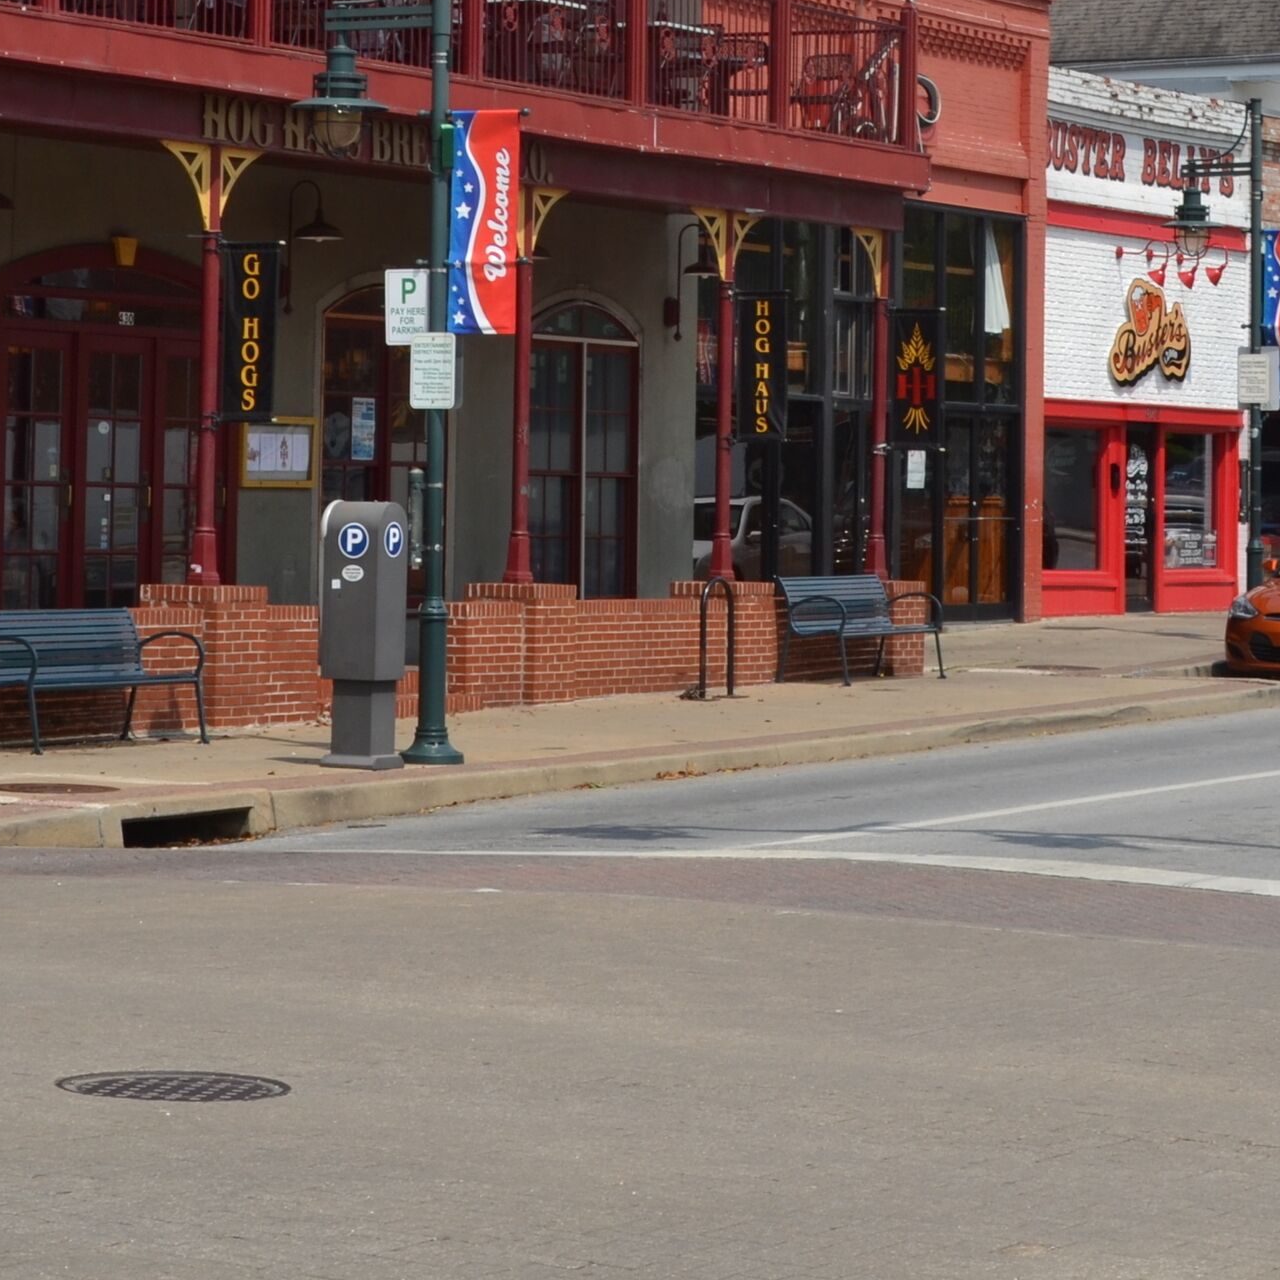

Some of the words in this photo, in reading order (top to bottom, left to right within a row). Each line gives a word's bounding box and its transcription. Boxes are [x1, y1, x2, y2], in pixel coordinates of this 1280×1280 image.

[202, 93, 274, 148] HOG
[483, 147, 511, 282] Welcome
[242, 253, 260, 300] GO
[390, 307, 404, 316] PAY
[406, 307, 426, 316] HERE
[391, 326, 424, 334] PARKING
[400, 316, 415, 325] FOR
[755, 300, 770, 353] HOG
[240, 318, 260, 412] HOGS
[755, 363, 769, 433] HAUS
